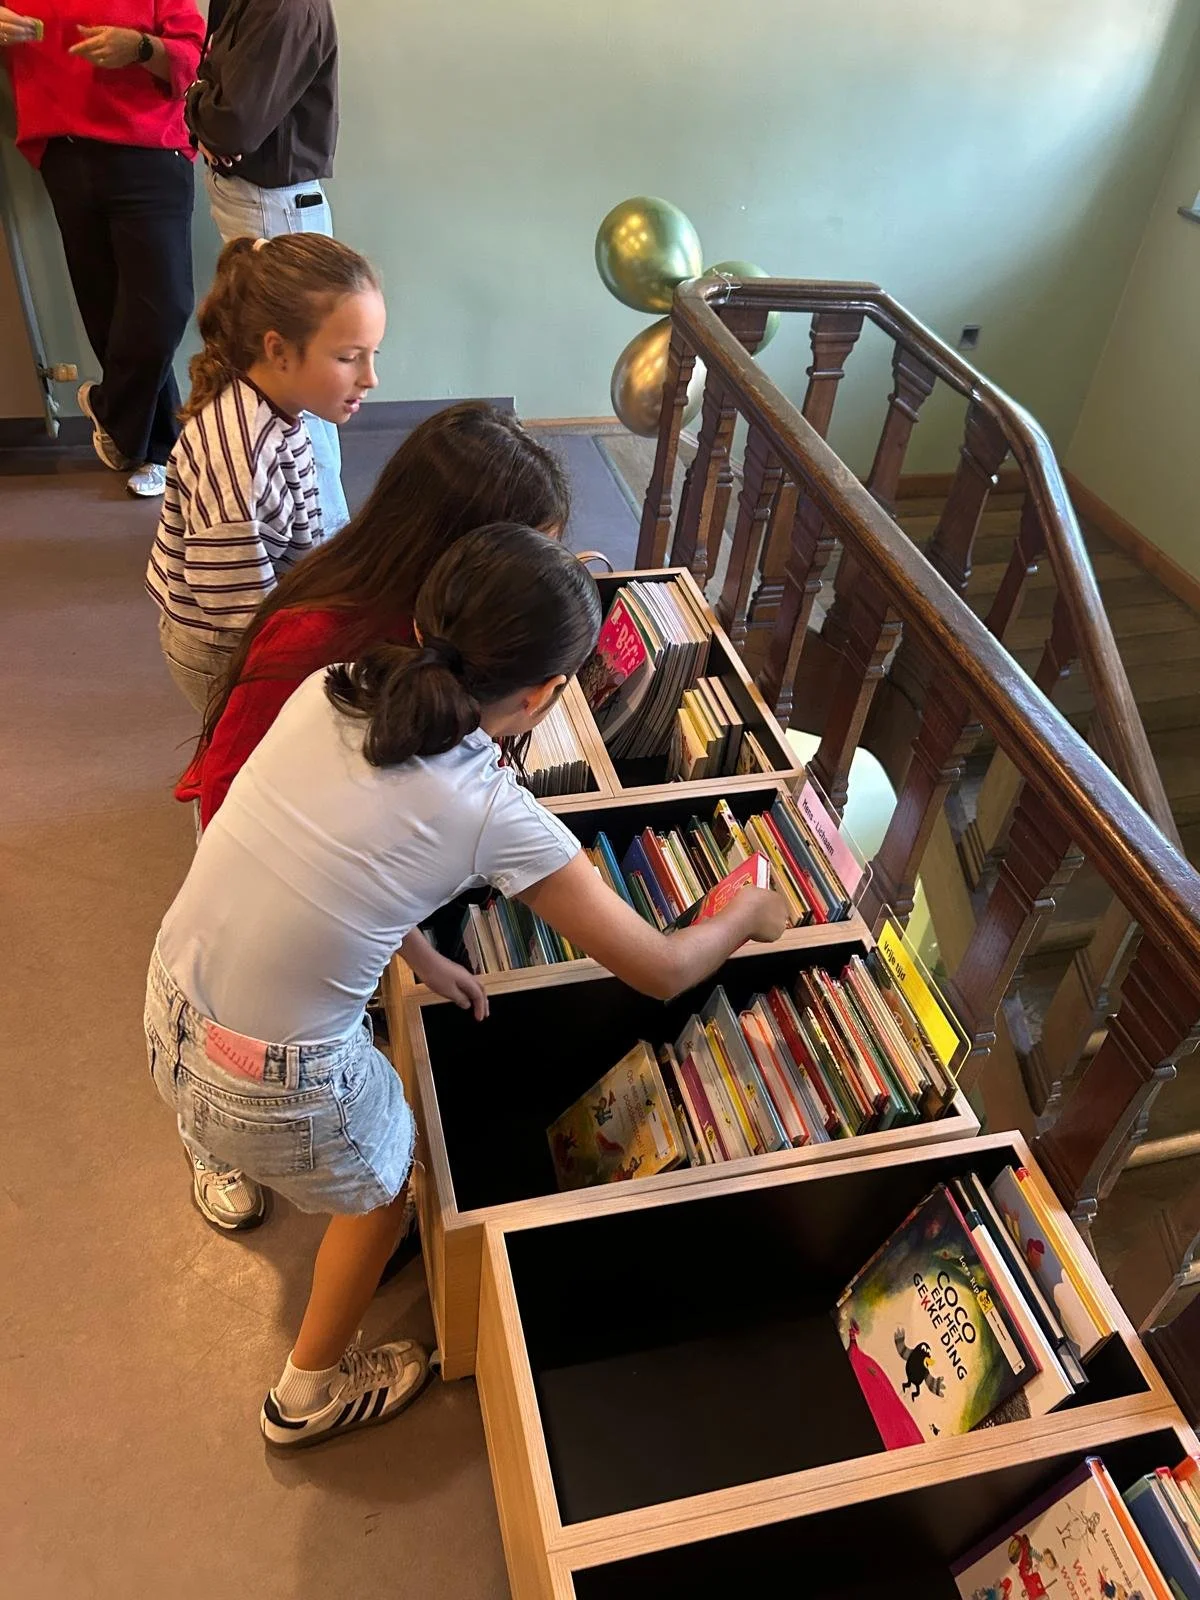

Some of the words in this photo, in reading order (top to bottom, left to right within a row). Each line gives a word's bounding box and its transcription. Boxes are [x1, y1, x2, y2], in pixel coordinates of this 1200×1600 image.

[802, 798, 814, 821] Mens
[815, 821, 835, 856] Lichaam
[883, 941, 896, 966] Vrije
[895, 962, 906, 982] tijd
[913, 1272, 943, 1329] GEKKE
[940, 1332, 968, 1380] DING
[930, 1287, 946, 1311] EN
[943, 1312, 963, 1345] HET
[936, 1270, 976, 1344] COCO
[1073, 1558, 1092, 1595] Wat
